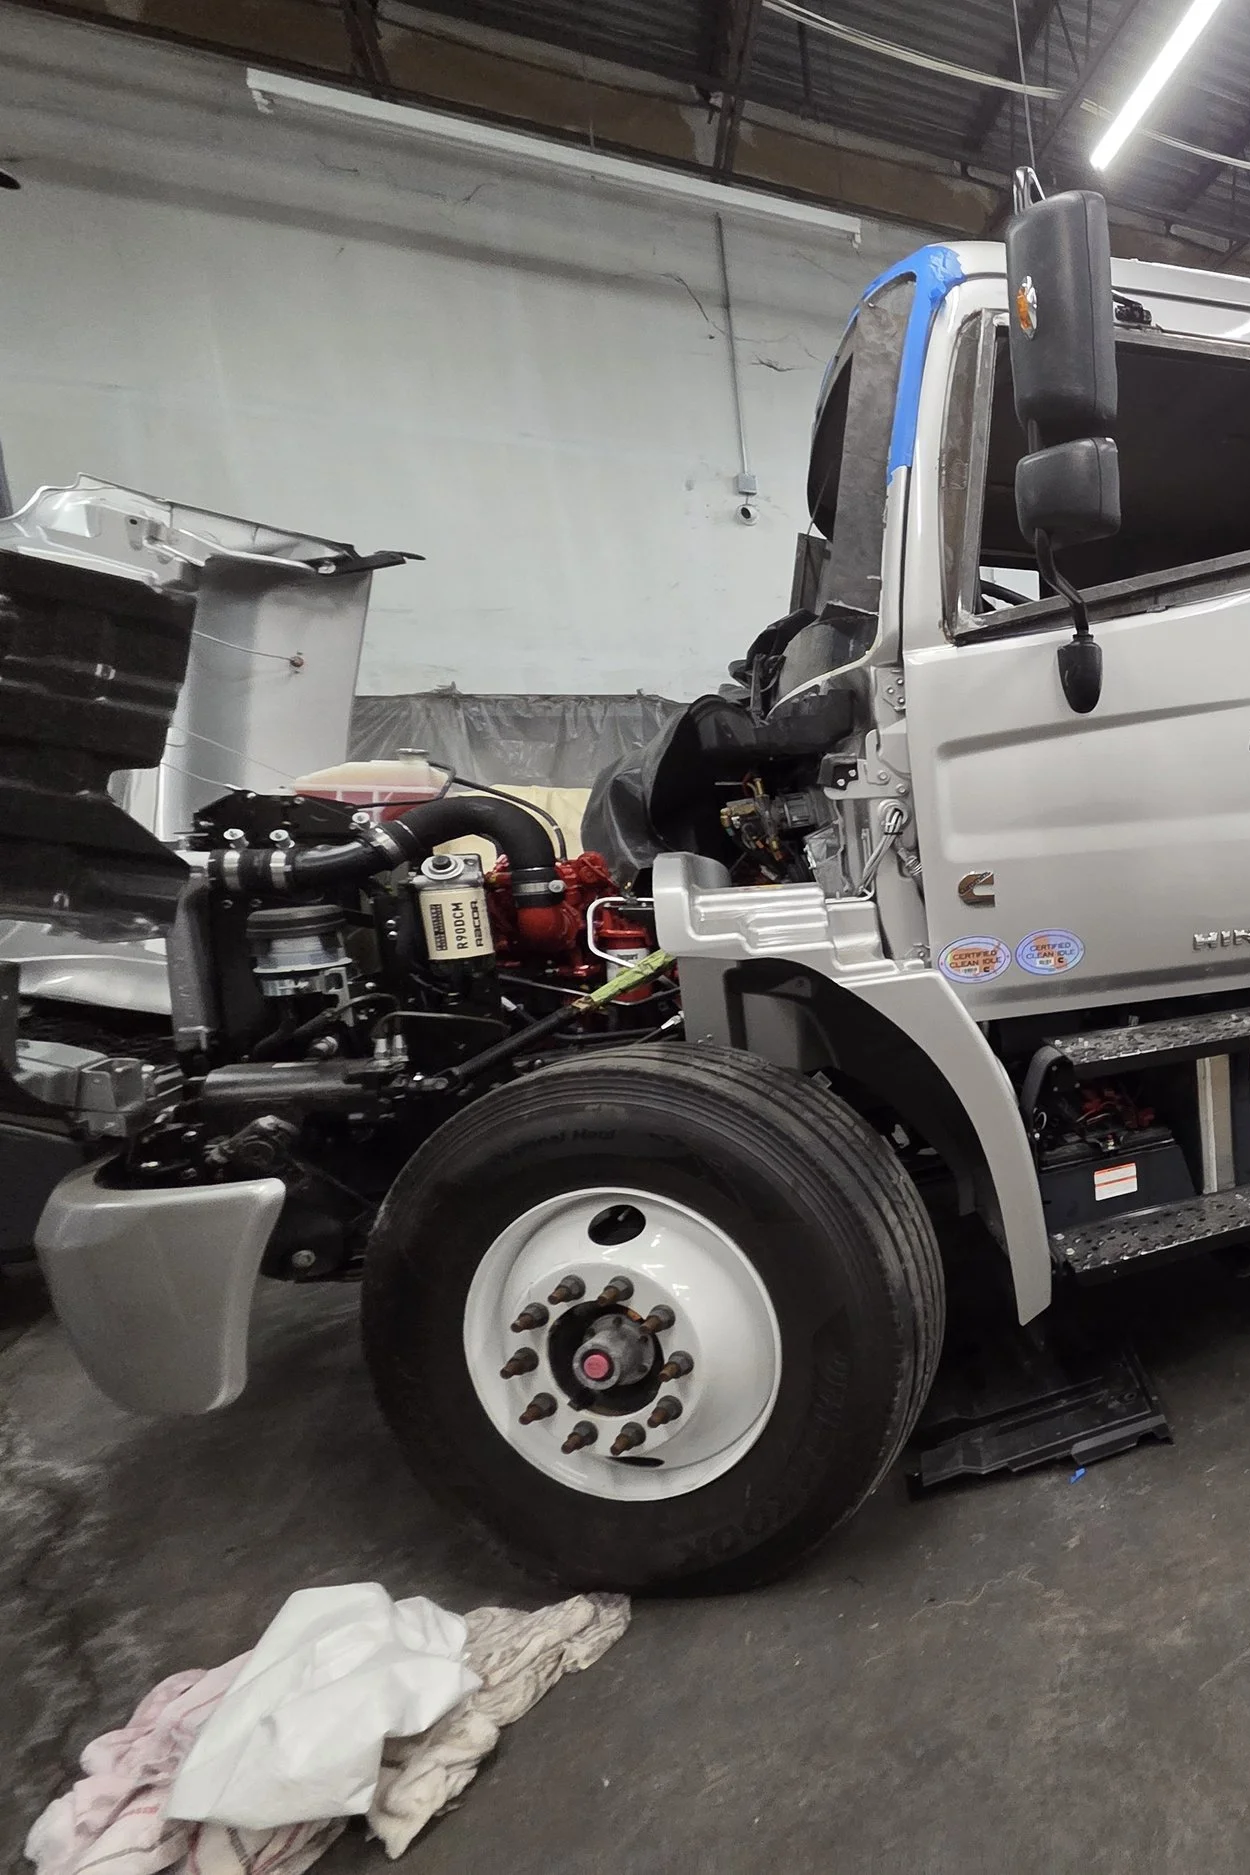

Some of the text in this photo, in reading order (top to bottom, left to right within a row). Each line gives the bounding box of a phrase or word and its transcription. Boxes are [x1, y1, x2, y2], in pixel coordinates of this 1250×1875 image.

[451, 902, 469, 950] R90DCM
[1029, 942, 1071, 952] CERTIFIED
[952, 949, 998, 961] CERTIFIED
[1026, 948, 1075, 960] CLEAN IDLE
[949, 957, 1001, 969] CLEAN IDLE
